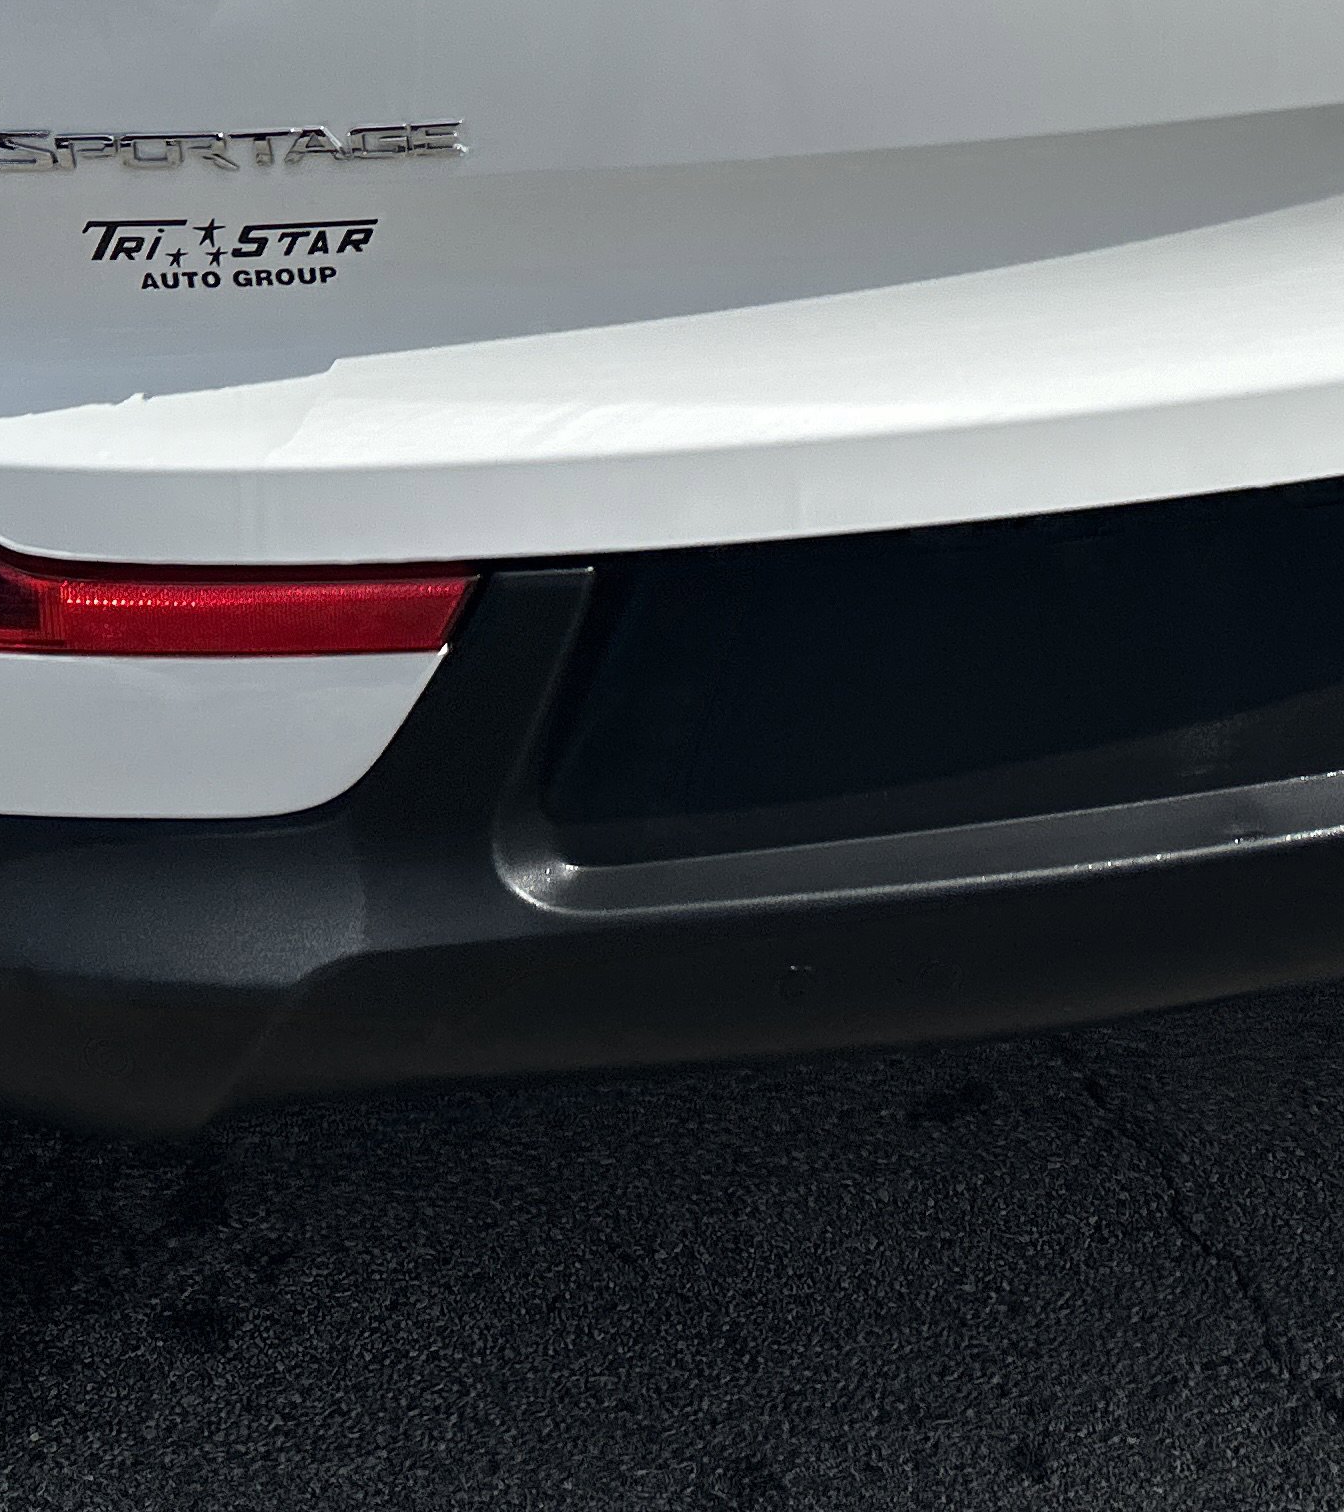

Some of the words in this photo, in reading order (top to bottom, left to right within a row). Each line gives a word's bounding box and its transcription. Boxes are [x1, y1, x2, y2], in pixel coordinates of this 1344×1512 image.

[231, 218, 379, 259] STAR
[140, 269, 222, 290] AUTO
[232, 266, 338, 288] GROUP
